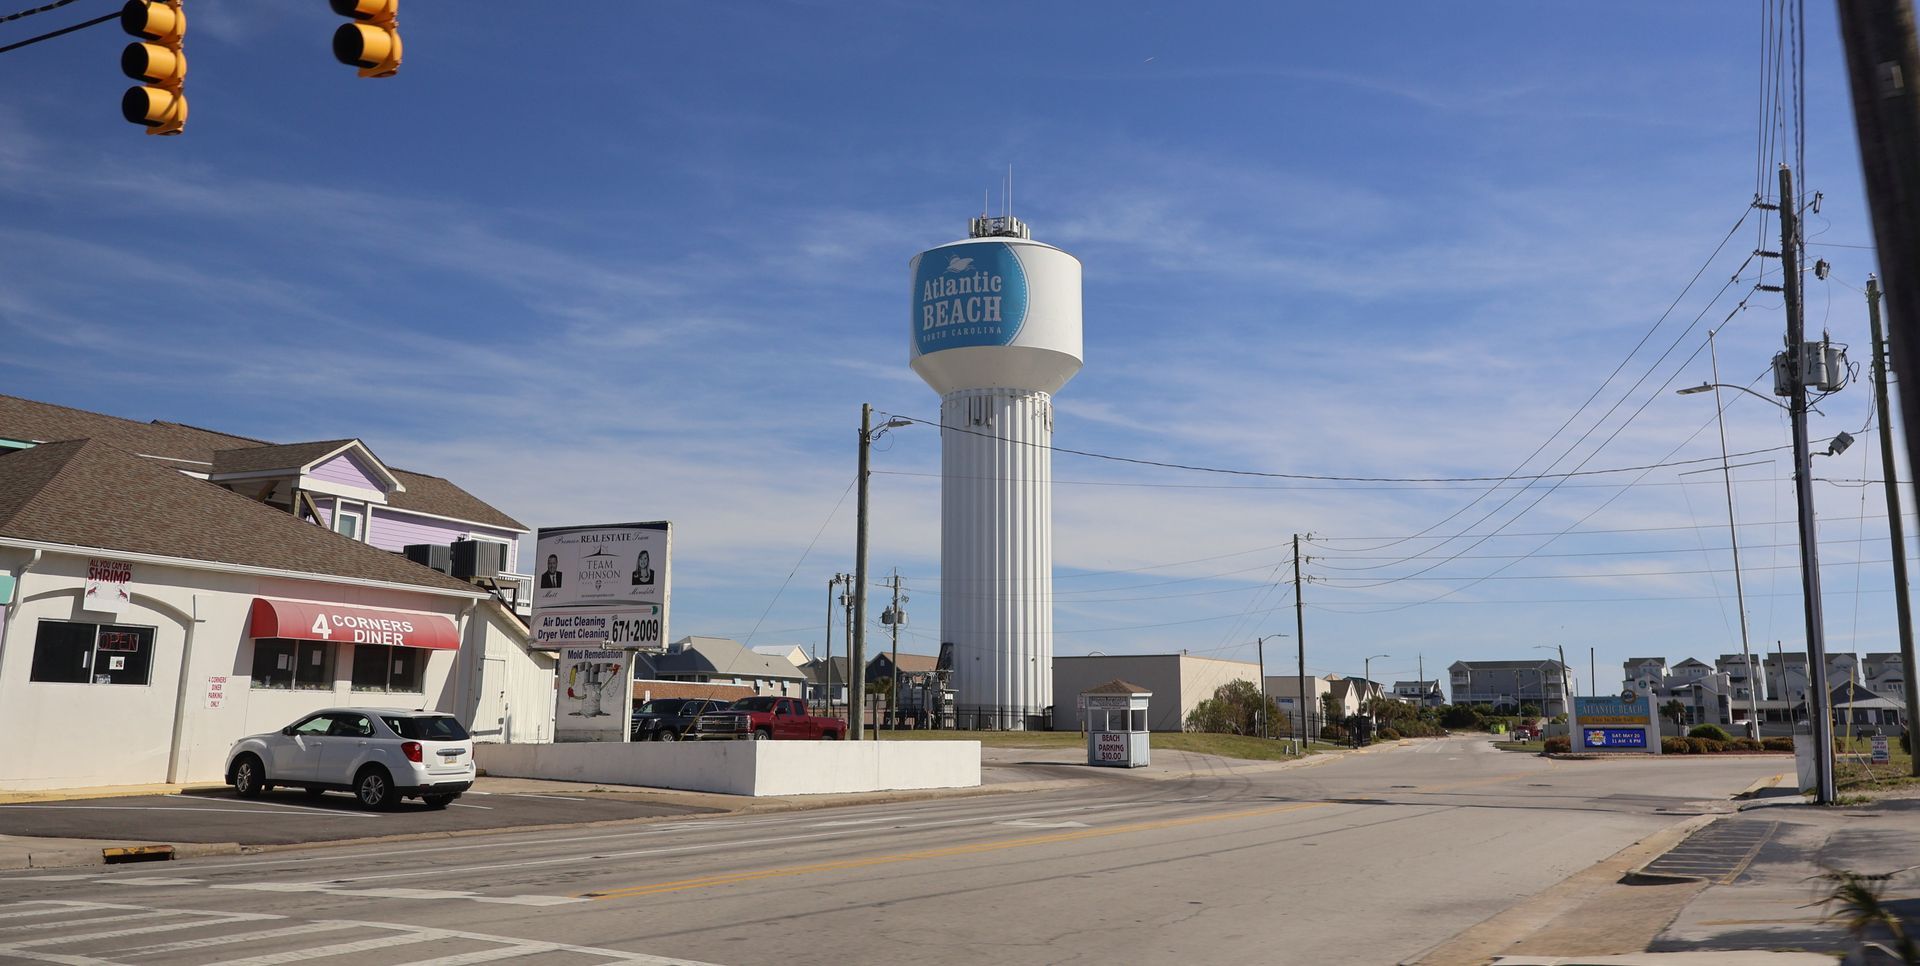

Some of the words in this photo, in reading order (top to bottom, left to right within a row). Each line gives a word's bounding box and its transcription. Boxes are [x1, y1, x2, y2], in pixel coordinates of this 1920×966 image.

[923, 271, 1002, 302] Atlantic
[923, 296, 1002, 331] BEACH
[923, 330, 946, 343] NORTH
[951, 326, 1002, 337] CAROLINA
[580, 535, 601, 544] REAL
[602, 533, 631, 543] ESTATE
[89, 559, 99, 567] ALL
[100, 560, 110, 568] YOU
[112, 561, 122, 570] CAN
[122, 562, 132, 571] EAT
[586, 560, 613, 570] TEAM
[88, 566, 131, 584] SHRIMP
[579, 570, 621, 581] JOHNSON
[312, 613, 333, 640] 4
[332, 615, 414, 633] CORNERS
[543, 617, 554, 627] Air
[555, 617, 572, 627] Duct
[574, 616, 606, 628] Cleaning
[538, 630, 558, 641] Dryer
[559, 629, 576, 639] Vent
[578, 628, 609, 640] Cleaning
[612, 619, 659, 642] 671-2009
[99, 632, 137, 650] OPEN
[354, 629, 404, 646] DINER
[567, 649, 583, 659] Mold
[584, 649, 623, 659] Remediation
[1583, 704, 1616, 714] ATLANTIC
[1618, 704, 1643, 714] BEACH
[1098, 744, 1124, 752] PARKING
[1101, 752, 1122, 760] $10.00
